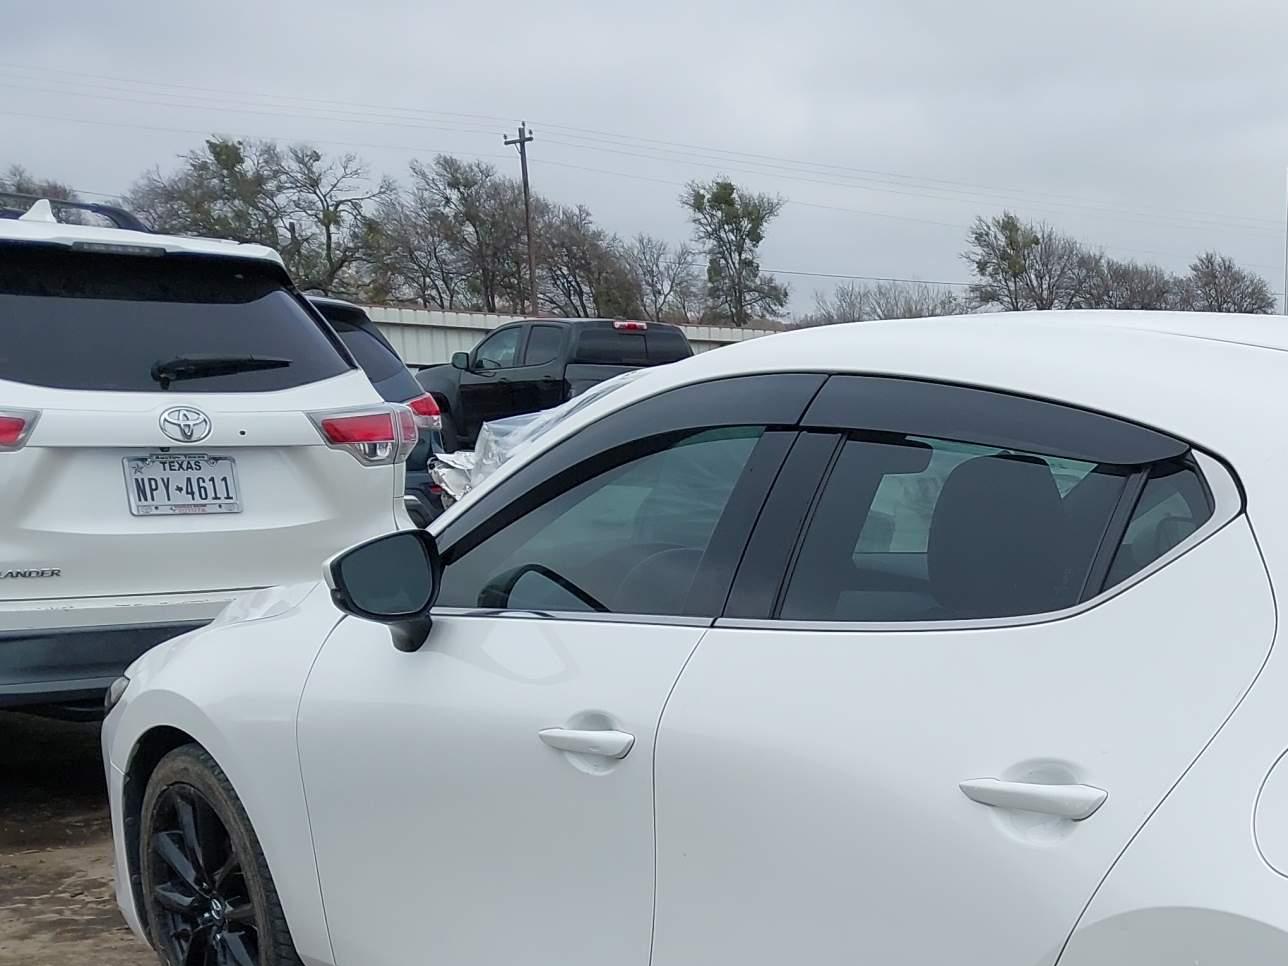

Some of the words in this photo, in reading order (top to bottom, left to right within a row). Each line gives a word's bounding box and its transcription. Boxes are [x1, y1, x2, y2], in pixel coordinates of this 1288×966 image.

[160, 460, 202, 472] TEXAS
[134, 477, 171, 503] NPY
[185, 475, 234, 502] 4611
